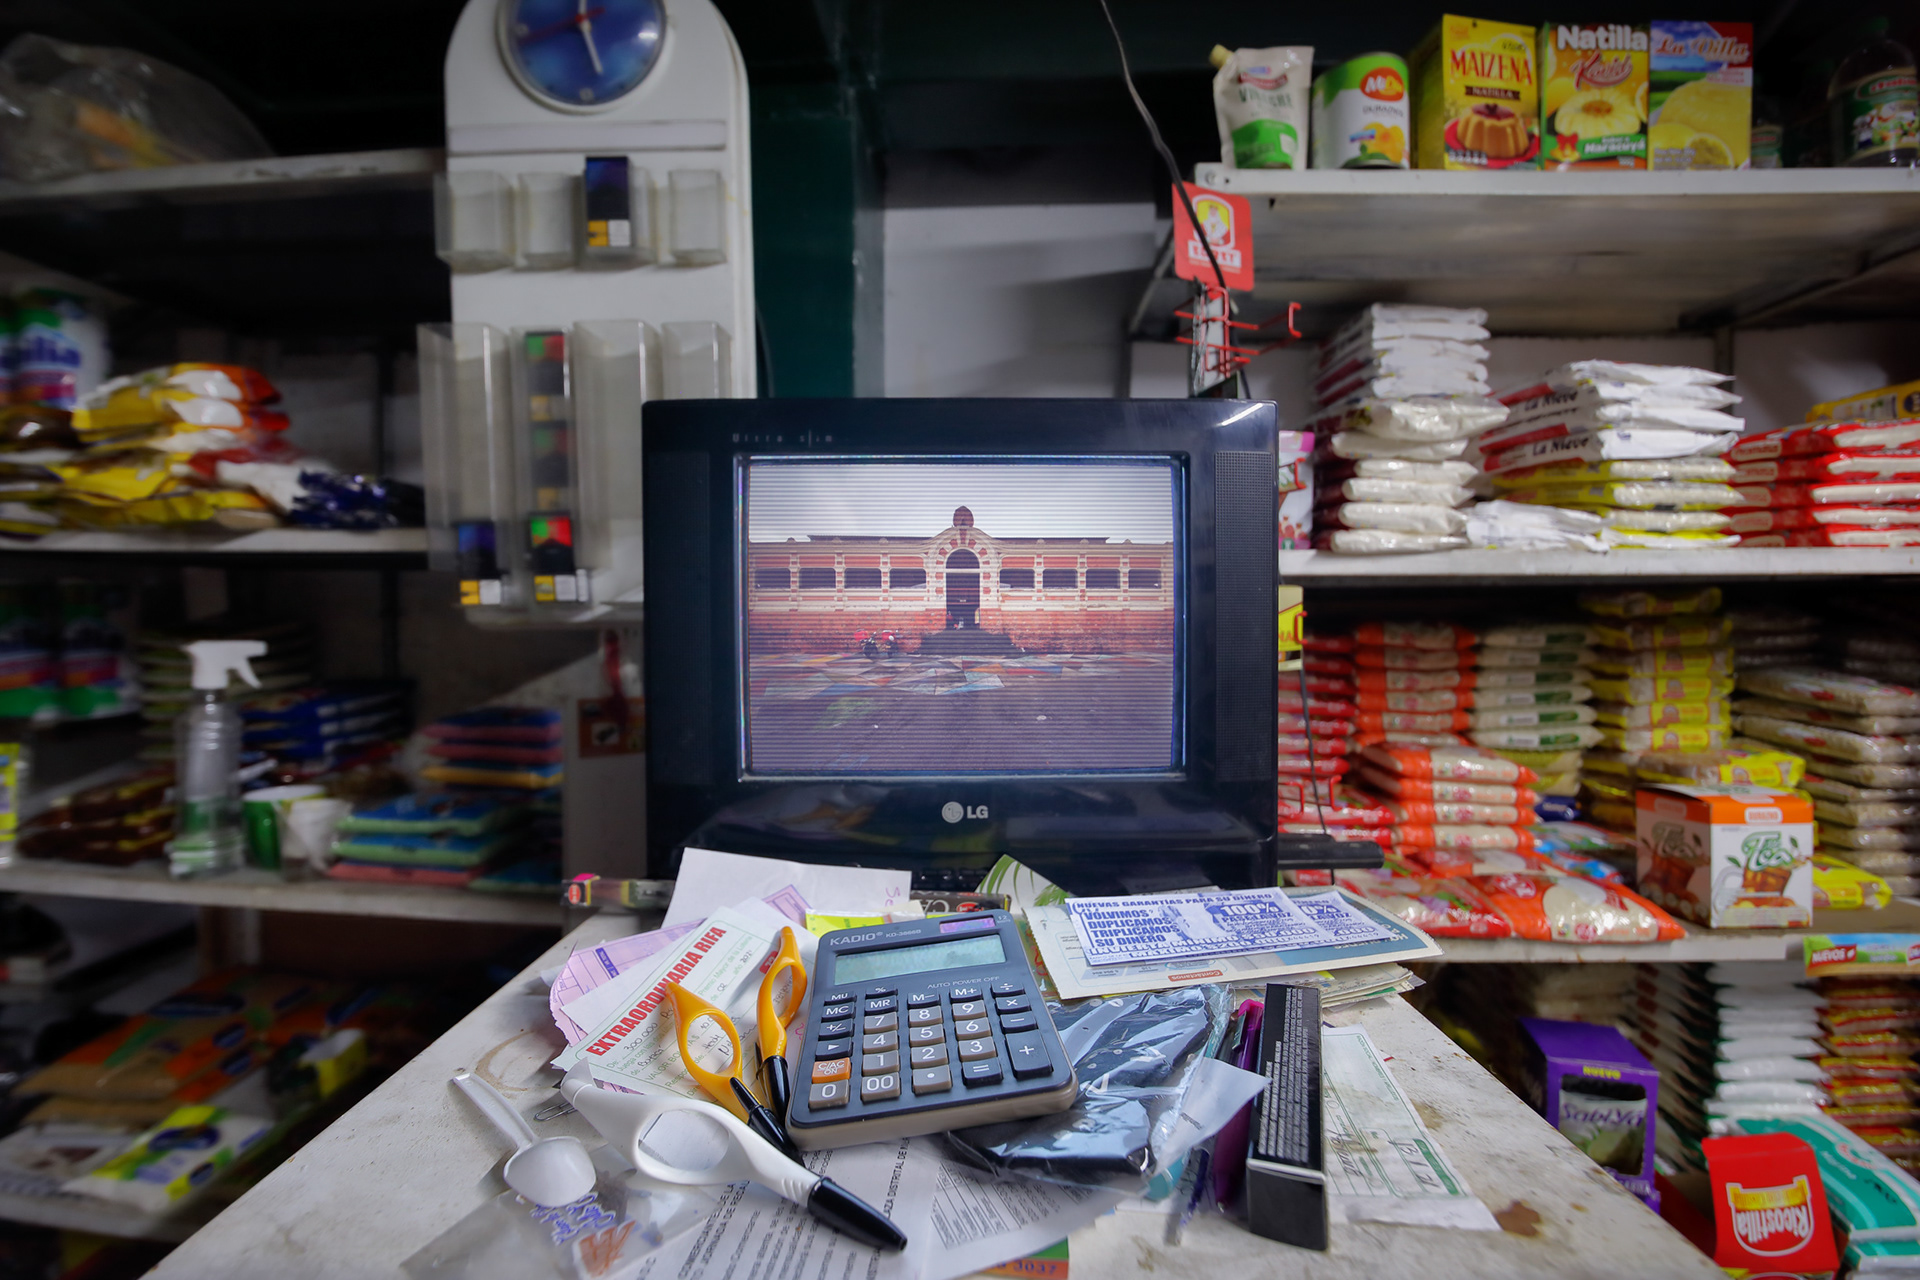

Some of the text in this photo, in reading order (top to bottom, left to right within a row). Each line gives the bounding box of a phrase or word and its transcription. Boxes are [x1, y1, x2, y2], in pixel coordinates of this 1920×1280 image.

[1557, 23, 1648, 51] Natilla
[1450, 48, 1532, 86] MAIZENA
[1472, 87, 1515, 99] NATILLA
[1585, 139, 1647, 154] Maracuyá
[732, 429, 833, 447] Ultra slim
[966, 805, 989, 819] LG
[1741, 830, 1794, 871] Tea
[1076, 901, 1120, 909] NUEVAS
[1185, 896, 1214, 904] PARA
[1235, 893, 1272, 901] DINERO
[1220, 902, 1280, 916] 100%
[1091, 924, 1181, 938] TRIPLICAMOS
[829, 933, 876, 946] KADIO
[1096, 934, 1166, 947] SU DINERO
[1812, 948, 1846, 963] NUEVOS
[952, 978, 982, 986] POWER
[984, 975, 1000, 983] OFF
[586, 951, 703, 1056] EXTRAORDINARIA
[693, 927, 727, 953] RIFA
[831, 993, 848, 1001] MU
[954, 987, 977, 997] M+
[826, 1005, 849, 1016] MC
[870, 999, 890, 1009] MR
[962, 1003, 974, 1014] 9
[919, 1009, 930, 1019] 8
[875, 1016, 884, 1027] 7
[966, 1020, 979, 1031] 6
[921, 1027, 933, 1038] 5
[872, 1035, 886, 1046] 4
[970, 1041, 983, 1052] 3
[922, 1048, 934, 1060] 2
[647, 1060, 670, 1083] VALOR
[818, 1060, 845, 1070] C/AC
[824, 1068, 838, 1076] ON
[1583, 1065, 1622, 1080] NUEVO
[867, 1076, 894, 1091] 00
[821, 1084, 837, 1098] 0
[888, 1160, 905, 1196] DISTRITAL
[1736, 1204, 1808, 1244] Ricostilla
[1014, 1259, 1057, 1276] 3037
